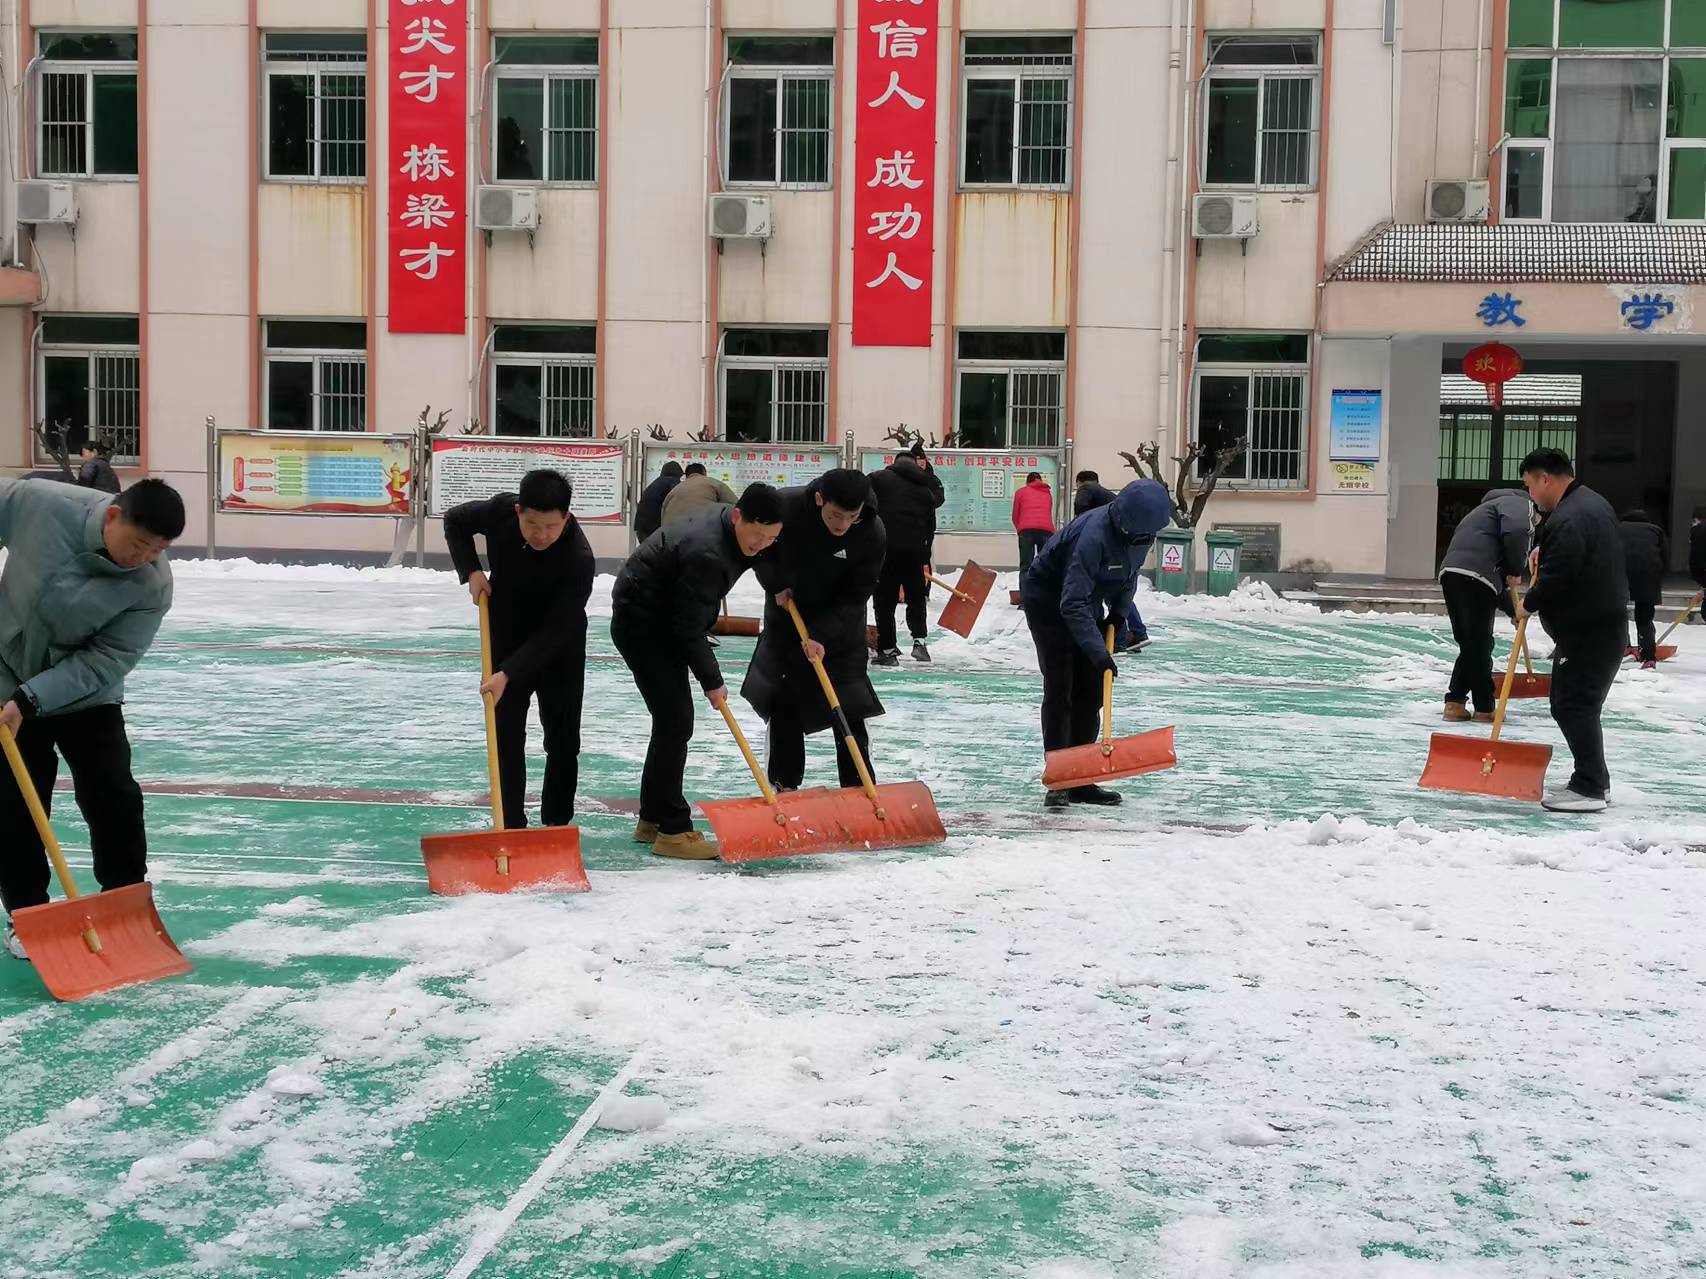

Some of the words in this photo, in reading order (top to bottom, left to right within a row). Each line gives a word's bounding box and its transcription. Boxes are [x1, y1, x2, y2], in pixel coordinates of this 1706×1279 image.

[399, 0, 455, 103] 尖才
[867, 0, 927, 110] 信人
[399, 143, 455, 280] 栋梁才
[866, 150, 923, 290] 成功人
